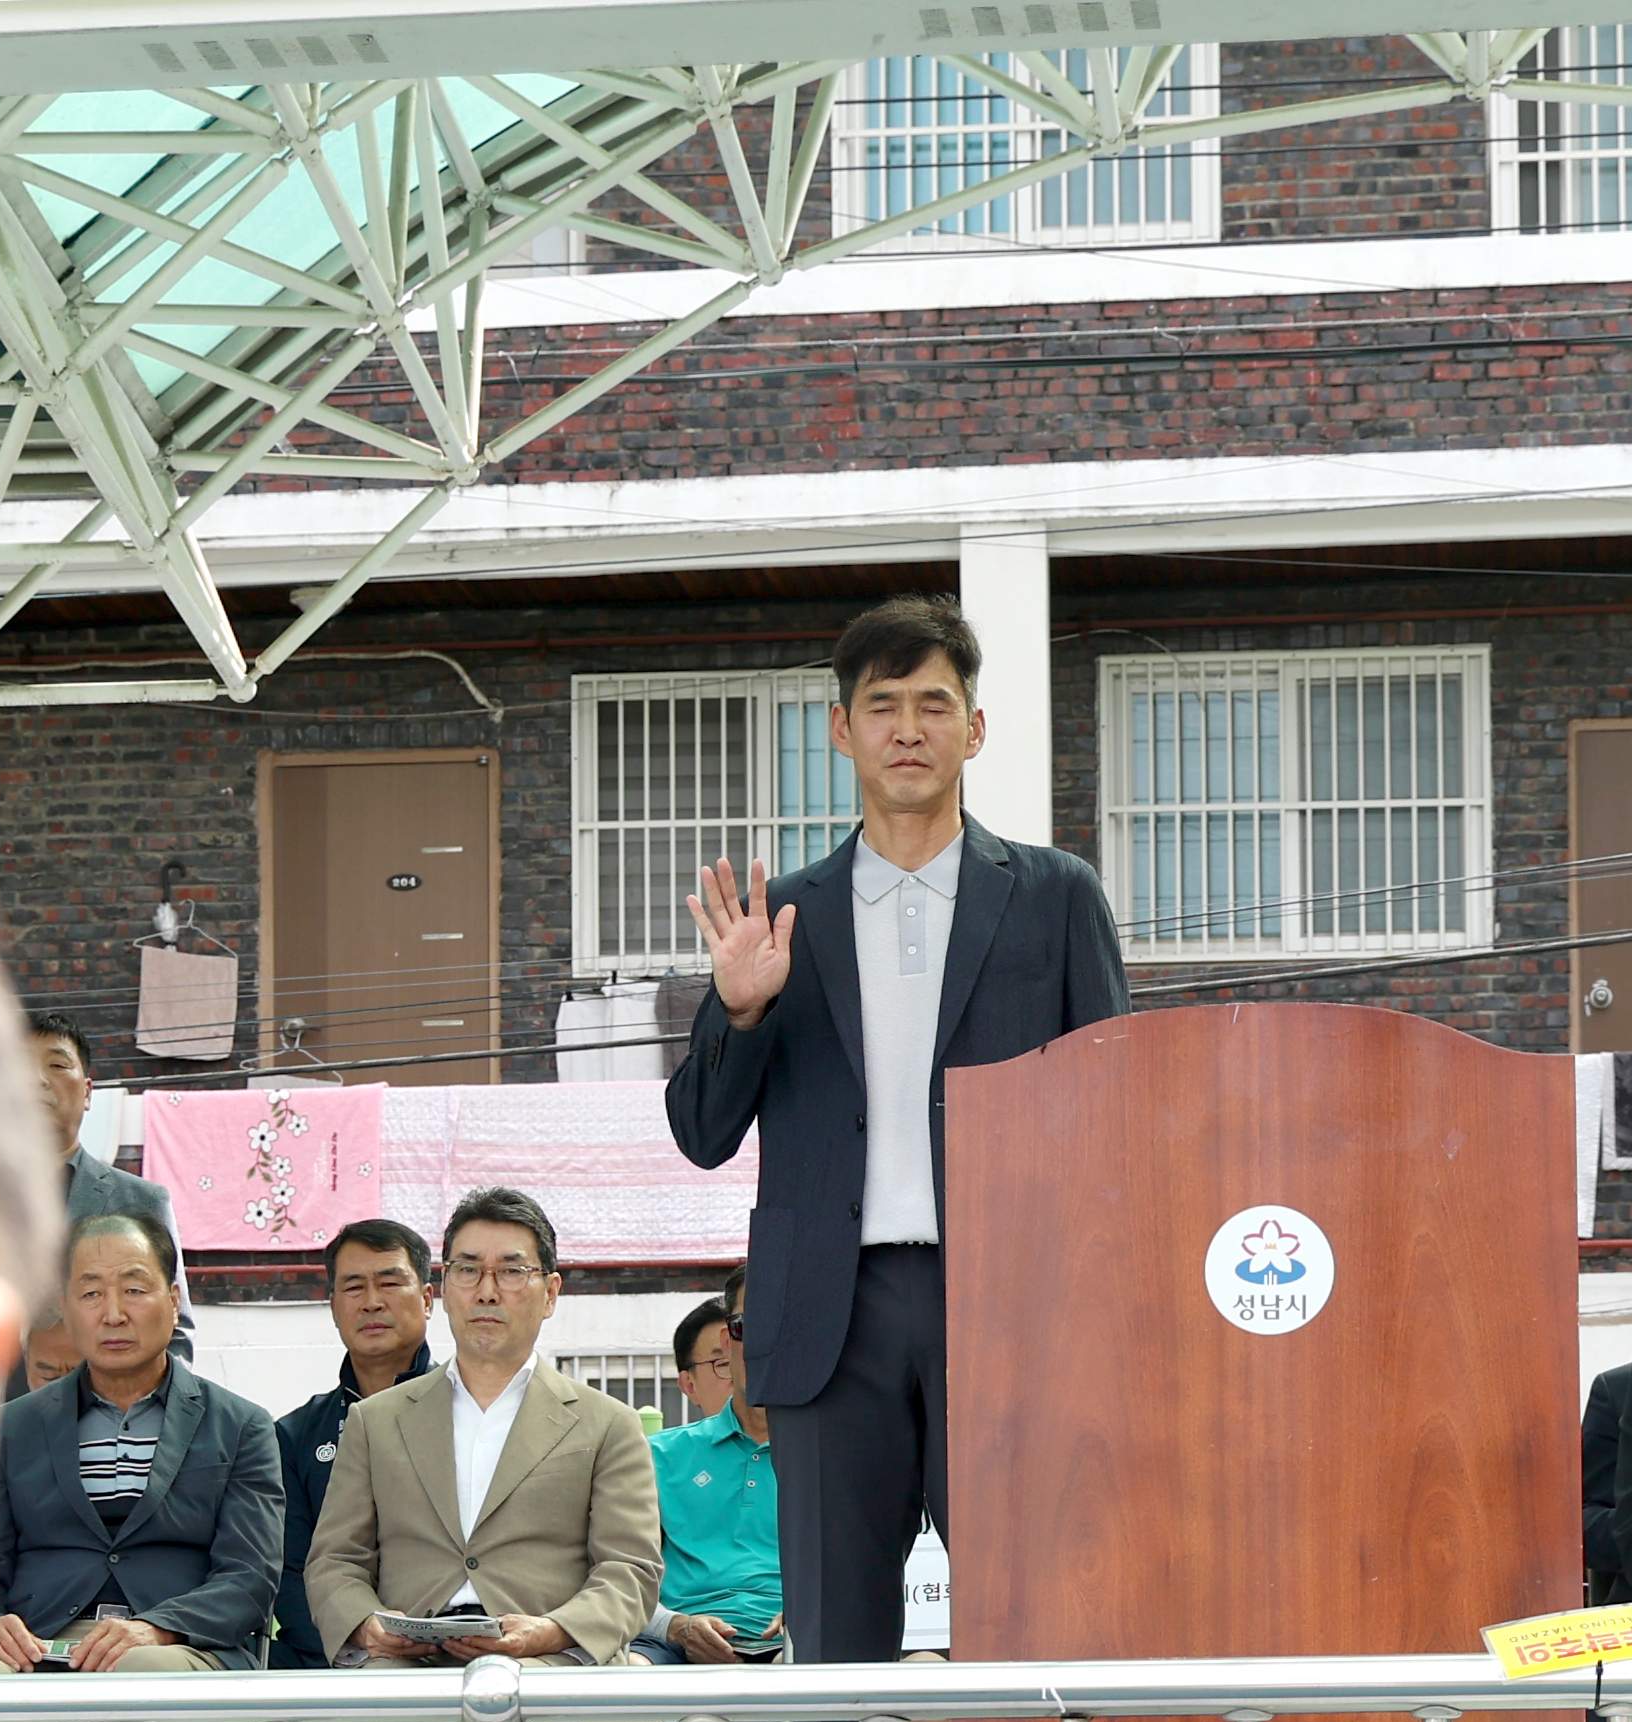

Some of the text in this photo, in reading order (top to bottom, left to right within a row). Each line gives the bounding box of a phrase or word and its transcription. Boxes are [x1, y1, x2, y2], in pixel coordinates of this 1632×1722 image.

[392, 876, 416, 887] 204
[1233, 1294, 1307, 1321] 성남시
[1509, 1627, 1573, 1642] HAZARD
